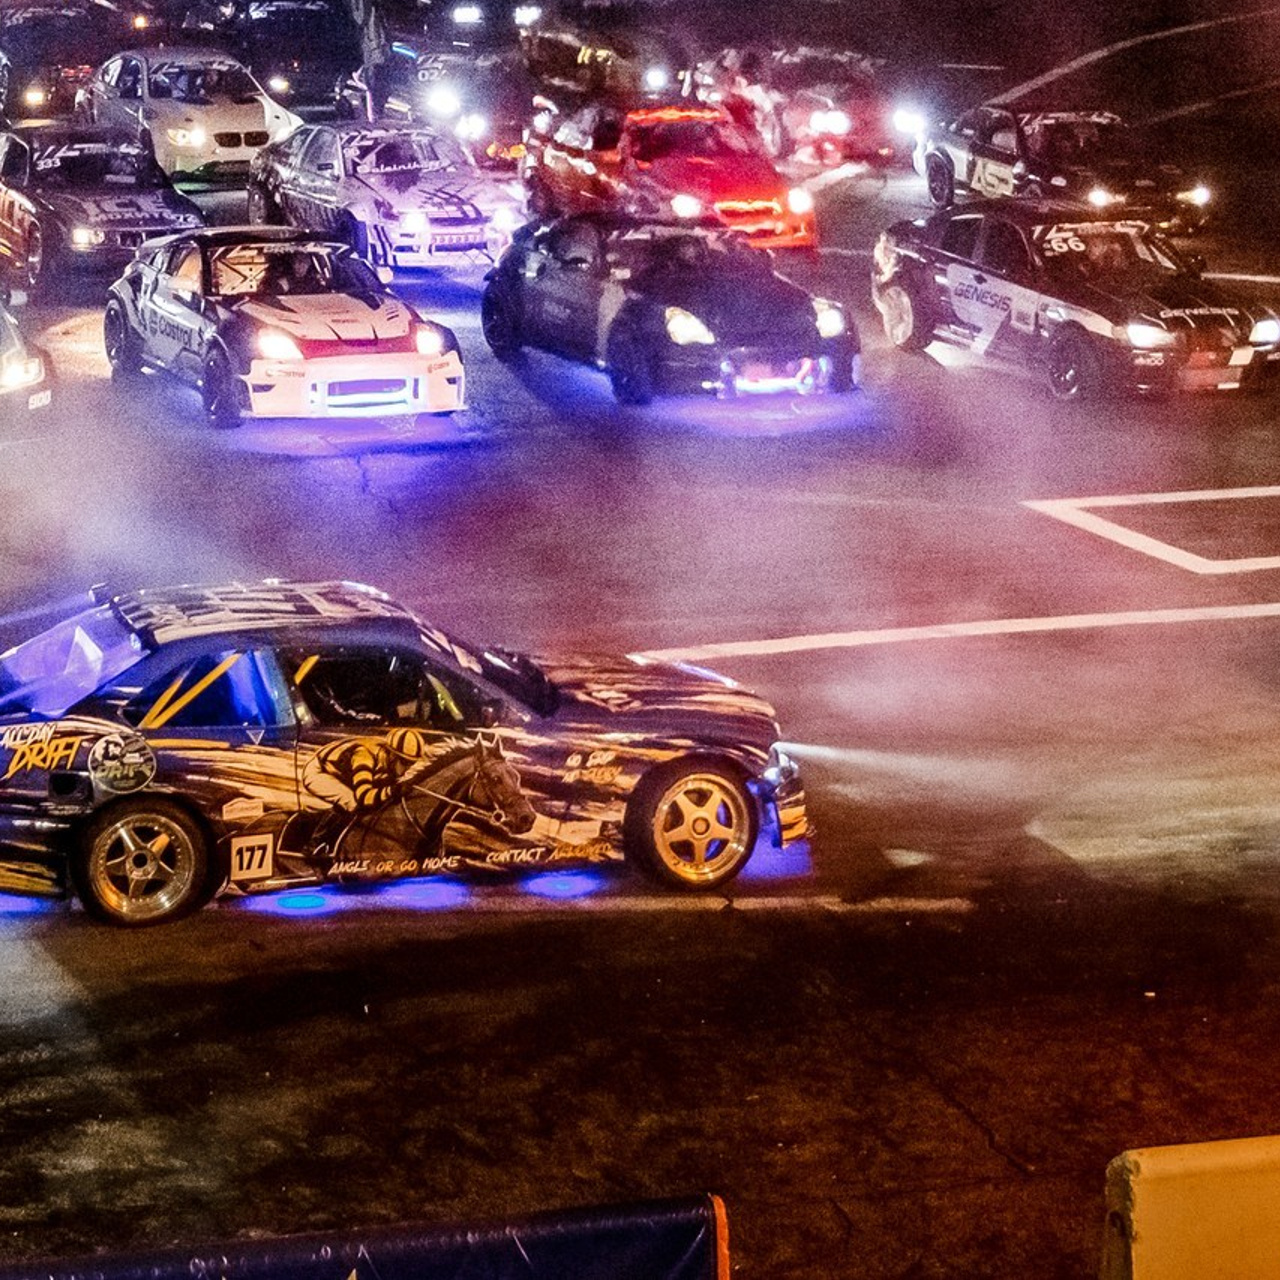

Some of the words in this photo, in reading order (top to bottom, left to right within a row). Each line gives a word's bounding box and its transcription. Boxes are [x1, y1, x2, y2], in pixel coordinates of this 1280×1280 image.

[35, 158, 61, 171] 333
[1051, 236, 1086, 252] 66
[954, 282, 1013, 312] GENESIS
[1159, 307, 1240, 319] GENESIS
[159, 315, 193, 348] Castrol
[26, 722, 58, 746] DAY
[236, 844, 268, 871] 177
[486, 847, 546, 863] CONTACT
[329, 859, 371, 875] ANGLE
[377, 860, 393, 872] OR
[400, 859, 418, 872] GO
[422, 856, 461, 870] HOME
